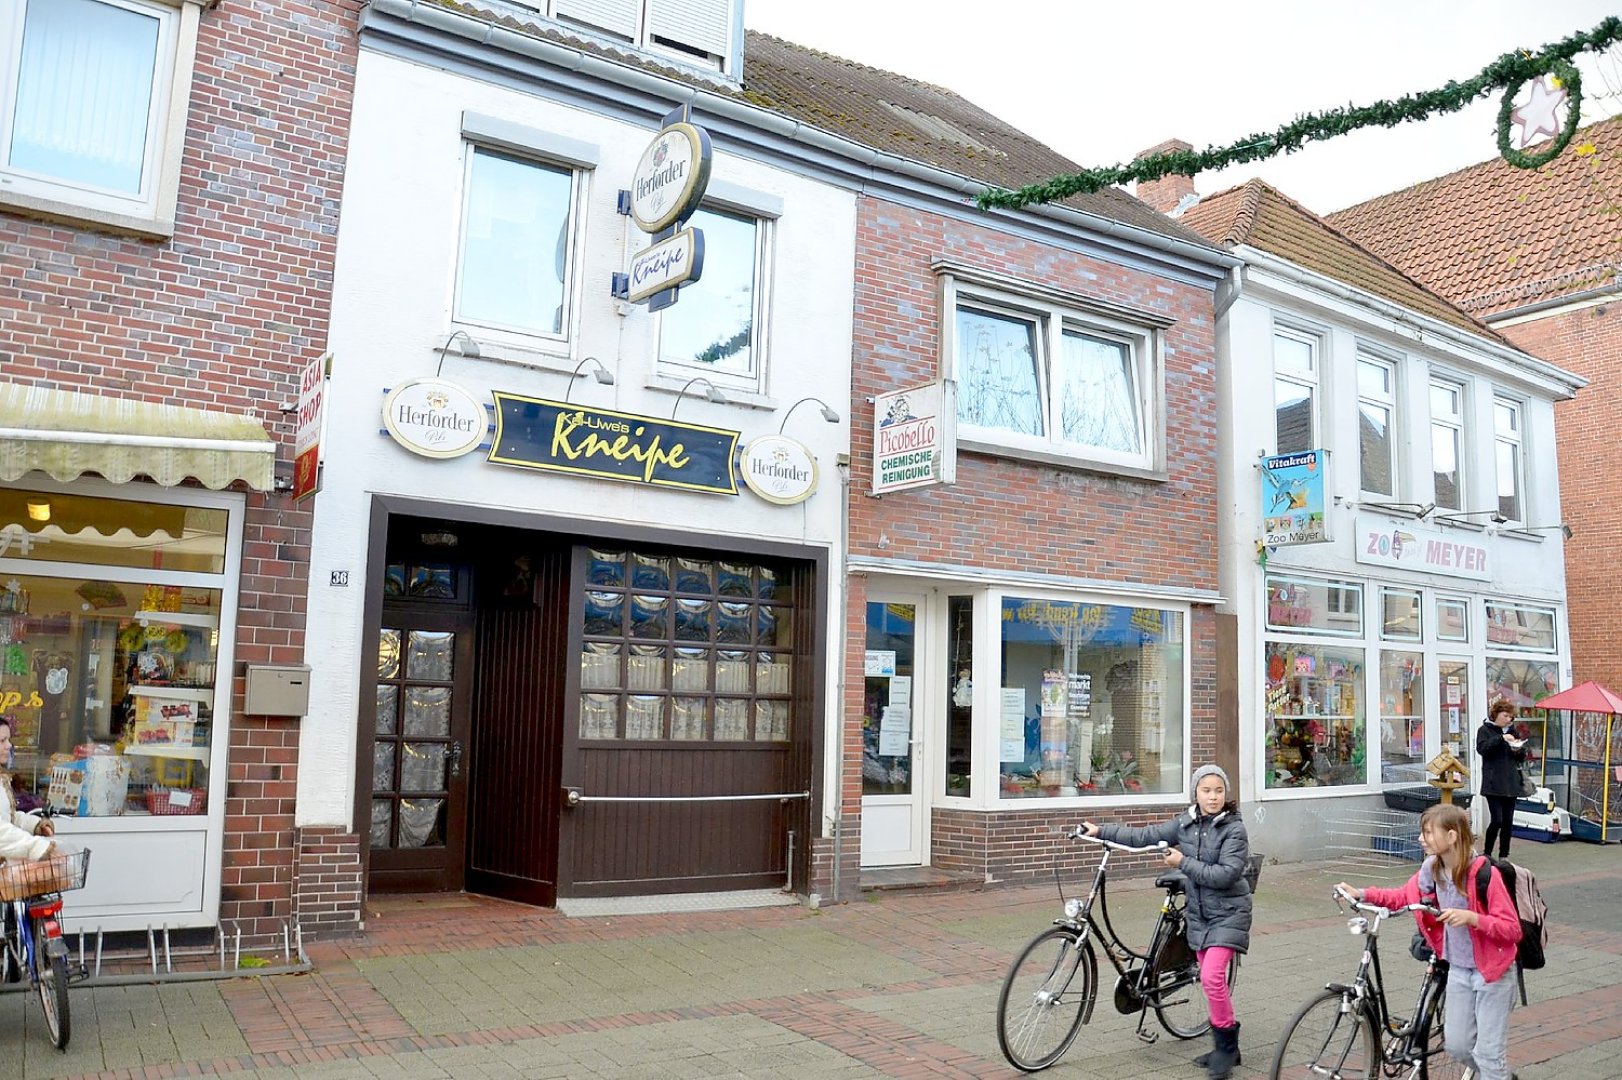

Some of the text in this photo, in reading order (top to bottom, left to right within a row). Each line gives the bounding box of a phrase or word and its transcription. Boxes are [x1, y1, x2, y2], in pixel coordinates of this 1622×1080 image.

[636, 159, 686, 202] Herforder
[632, 248, 684, 287] Kneipe
[303, 360, 321, 395] ASIA
[298, 391, 322, 431] SHOP
[399, 405, 474, 432] Herforder
[551, 411, 690, 482] Kneipe
[880, 421, 935, 453] Picobello
[753, 458, 809, 482] Herforder
[881, 450, 932, 470] CHEMISCHE
[1268, 454, 1315, 469] Vitakraft
[882, 465, 931, 484] REINIGUNG
[1267, 531, 1319, 544] Zoo Meyer
[1426, 540, 1487, 572] MEYER
[332, 571, 348, 585] 36
[0, 691, 44, 714] ps
